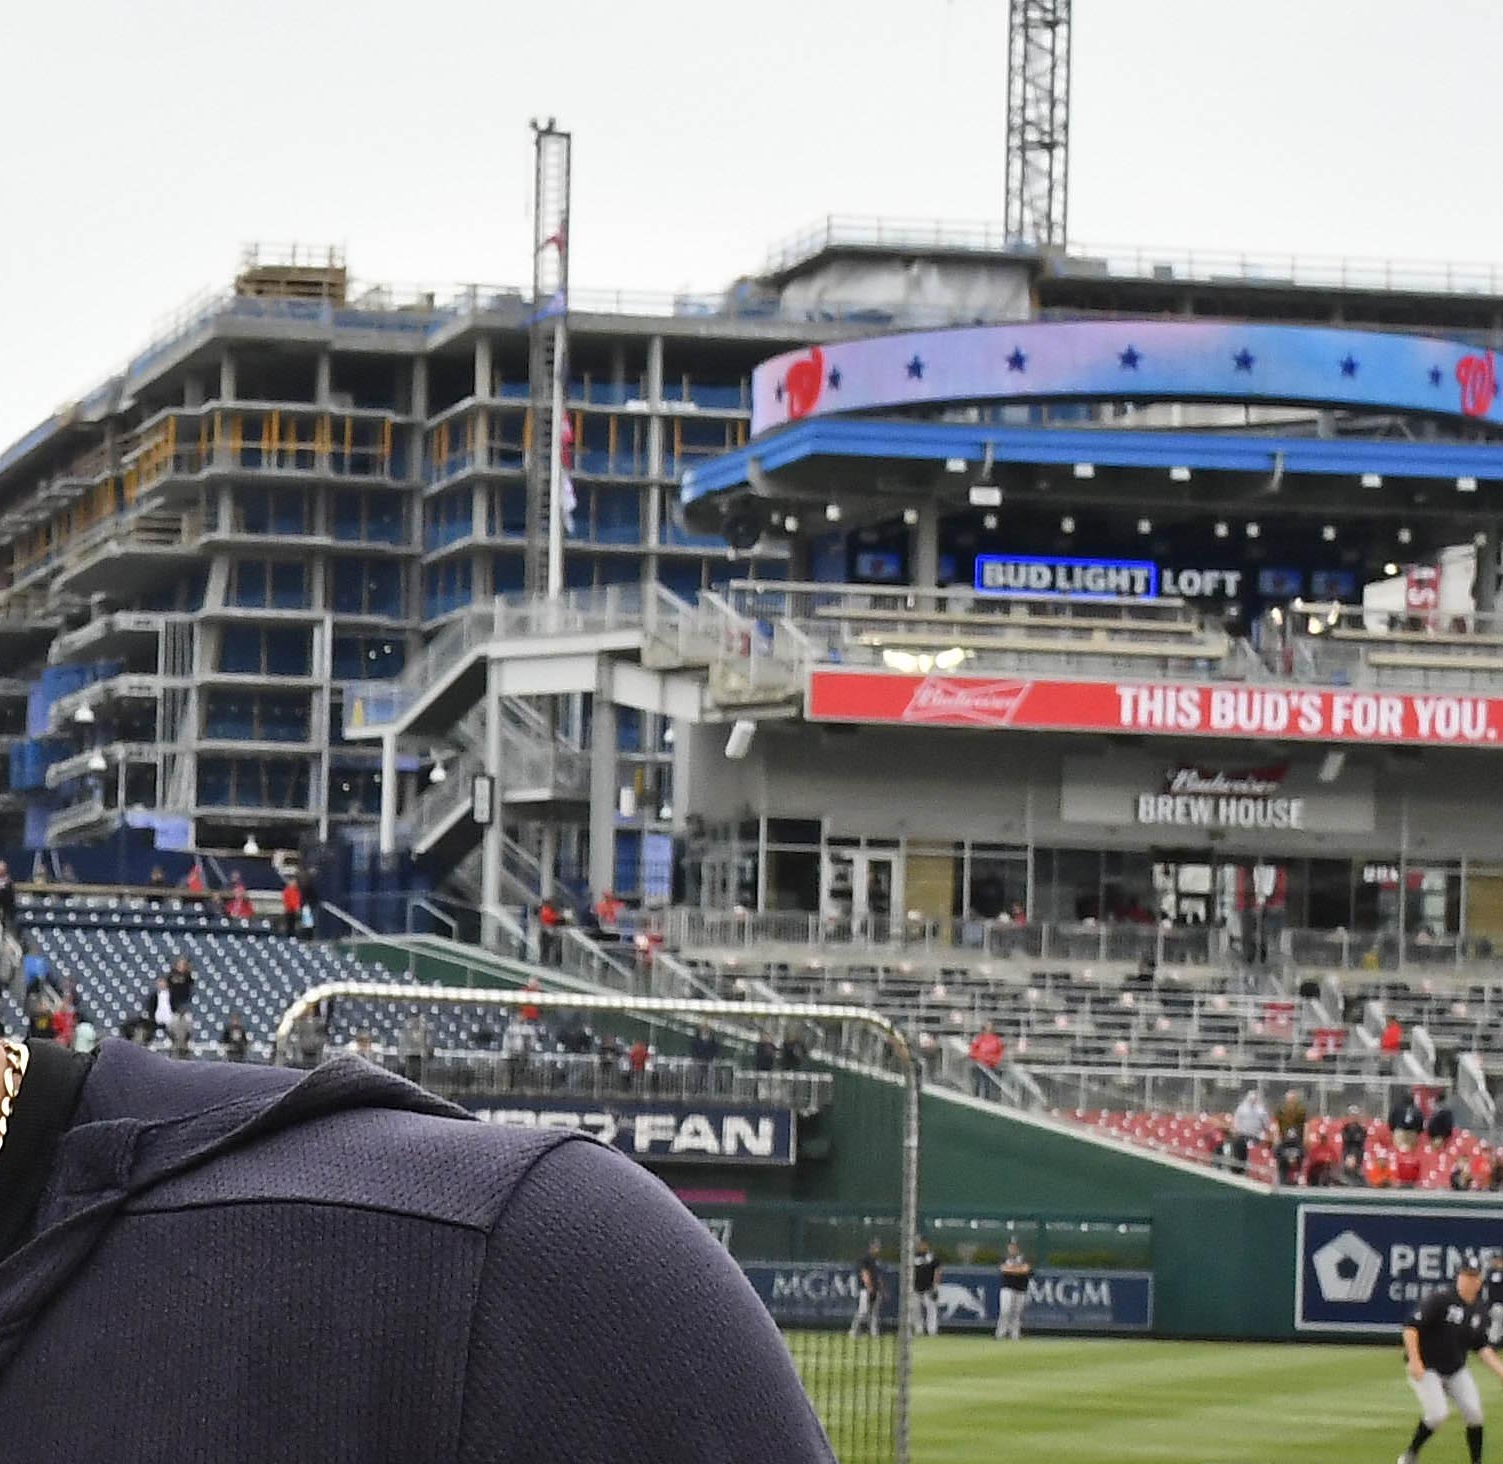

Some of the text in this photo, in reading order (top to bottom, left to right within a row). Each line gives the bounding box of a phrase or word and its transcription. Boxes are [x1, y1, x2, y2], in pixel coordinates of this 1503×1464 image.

[982, 561, 1241, 598] BUD LIGHT LOFT
[1116, 684, 1498, 740] THIS BUD'S FOR YOU.
[1138, 792, 1305, 831] BREW HOUSE
[633, 1112, 775, 1157] FAN
[771, 1270, 860, 1300] MGM
[1026, 1277, 1112, 1306] MGM
